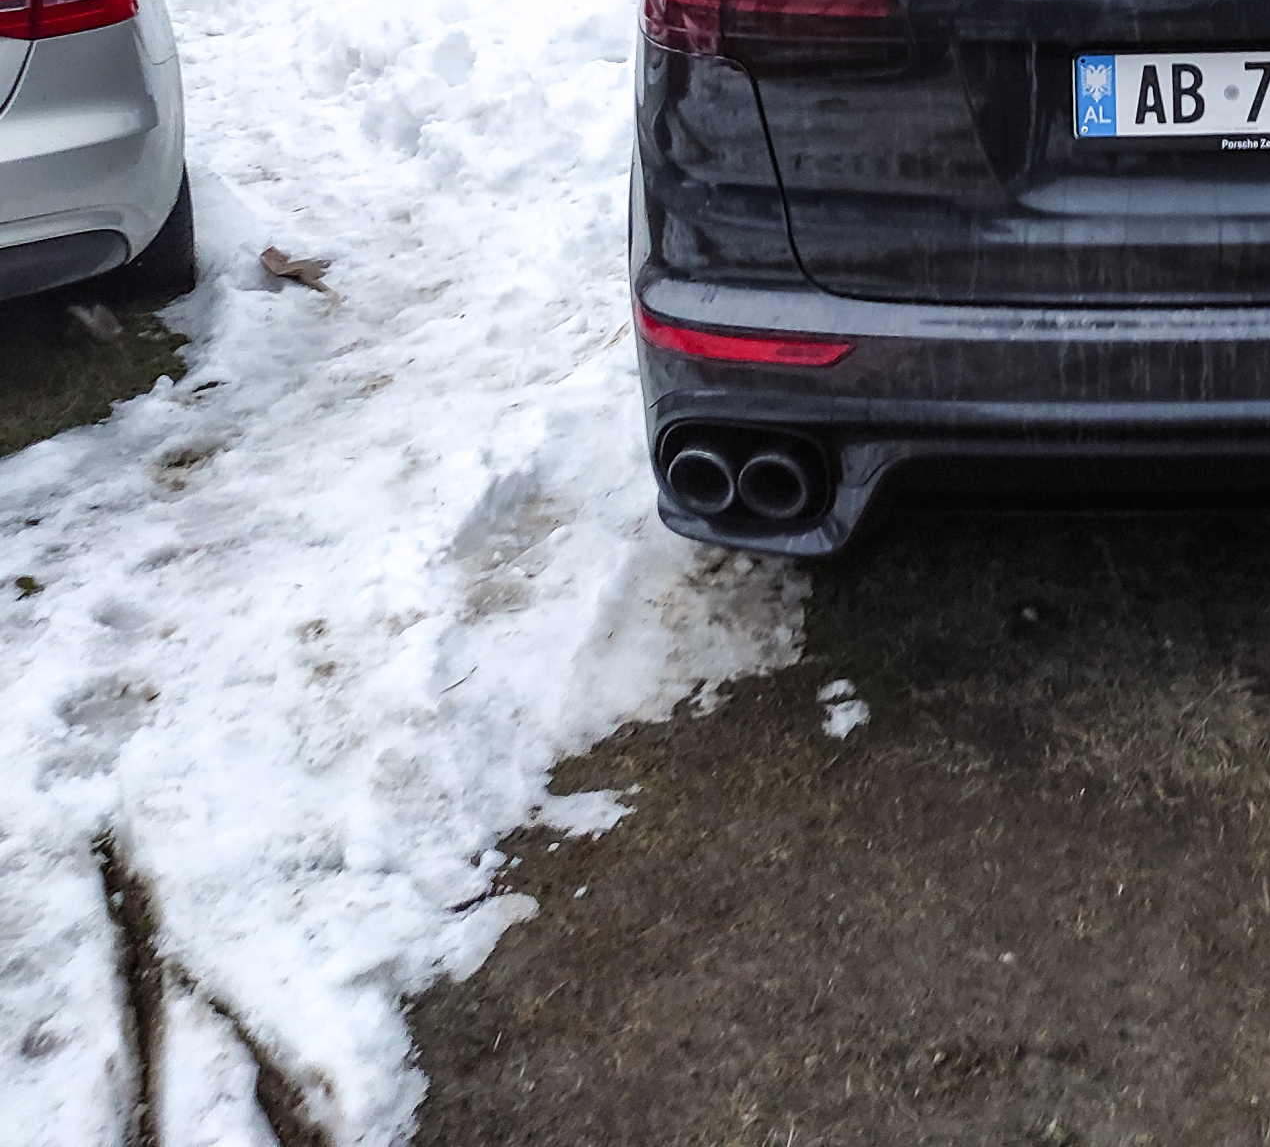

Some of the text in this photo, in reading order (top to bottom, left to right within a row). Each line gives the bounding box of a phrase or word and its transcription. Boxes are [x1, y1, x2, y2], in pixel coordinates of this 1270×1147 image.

[1135, 63, 1205, 125] AB
[1083, 105, 1112, 125] AL
[1221, 138, 1259, 150] Porsche
